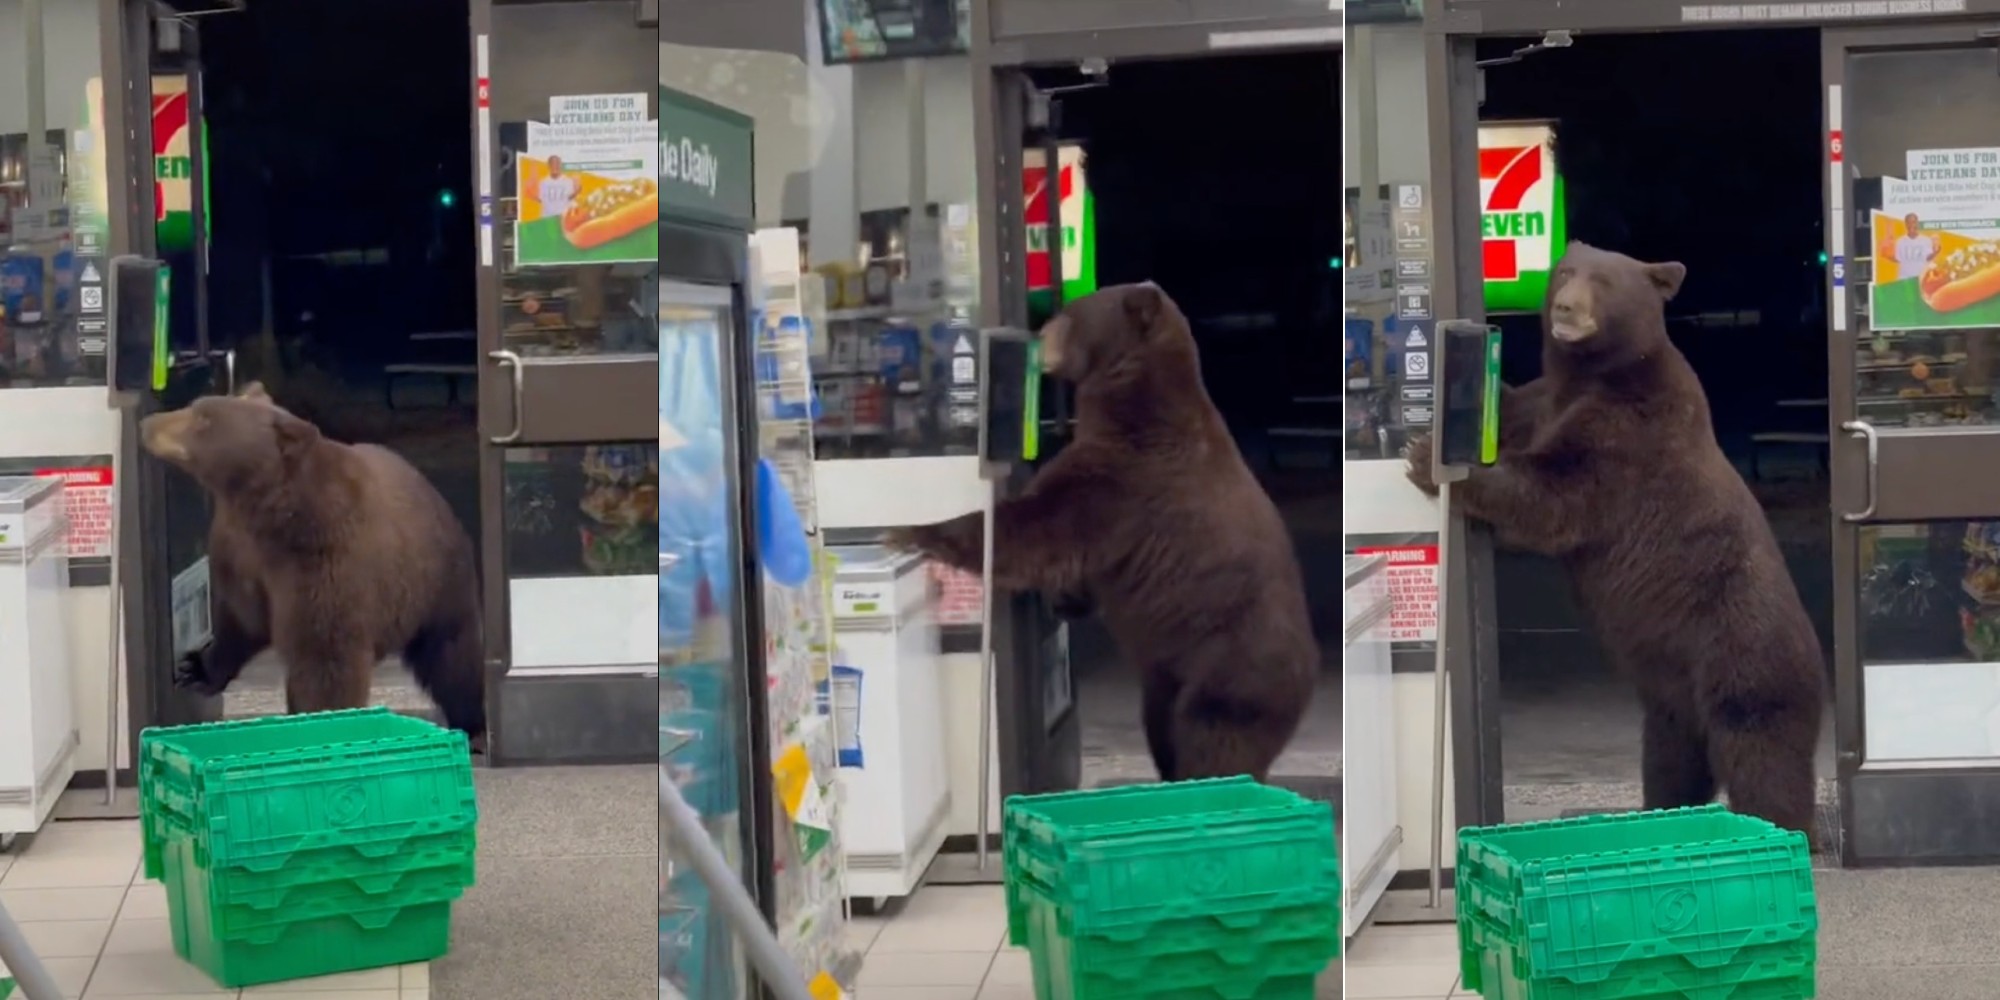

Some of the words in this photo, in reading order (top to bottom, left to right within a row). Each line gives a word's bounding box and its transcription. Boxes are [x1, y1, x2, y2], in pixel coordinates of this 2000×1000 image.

[1806, 2, 1852, 18] UNLOCKED
[1889, 0, 1932, 14] BUSINESS
[479, 86, 488, 98] 6
[594, 98, 608, 109] US
[613, 97, 634, 108] FOR
[553, 112, 615, 124] VETERANS
[618, 111, 641, 122] DAY
[1832, 138, 1842, 152] 6
[1921, 154, 1949, 166] JOIN
[1954, 153, 1969, 164] US
[1974, 152, 1998, 163] FOR
[681, 136, 717, 197] Daily
[1911, 167, 1976, 180] VETERANS
[481, 203, 491, 216] 5
[1833, 263, 1844, 278] 5
